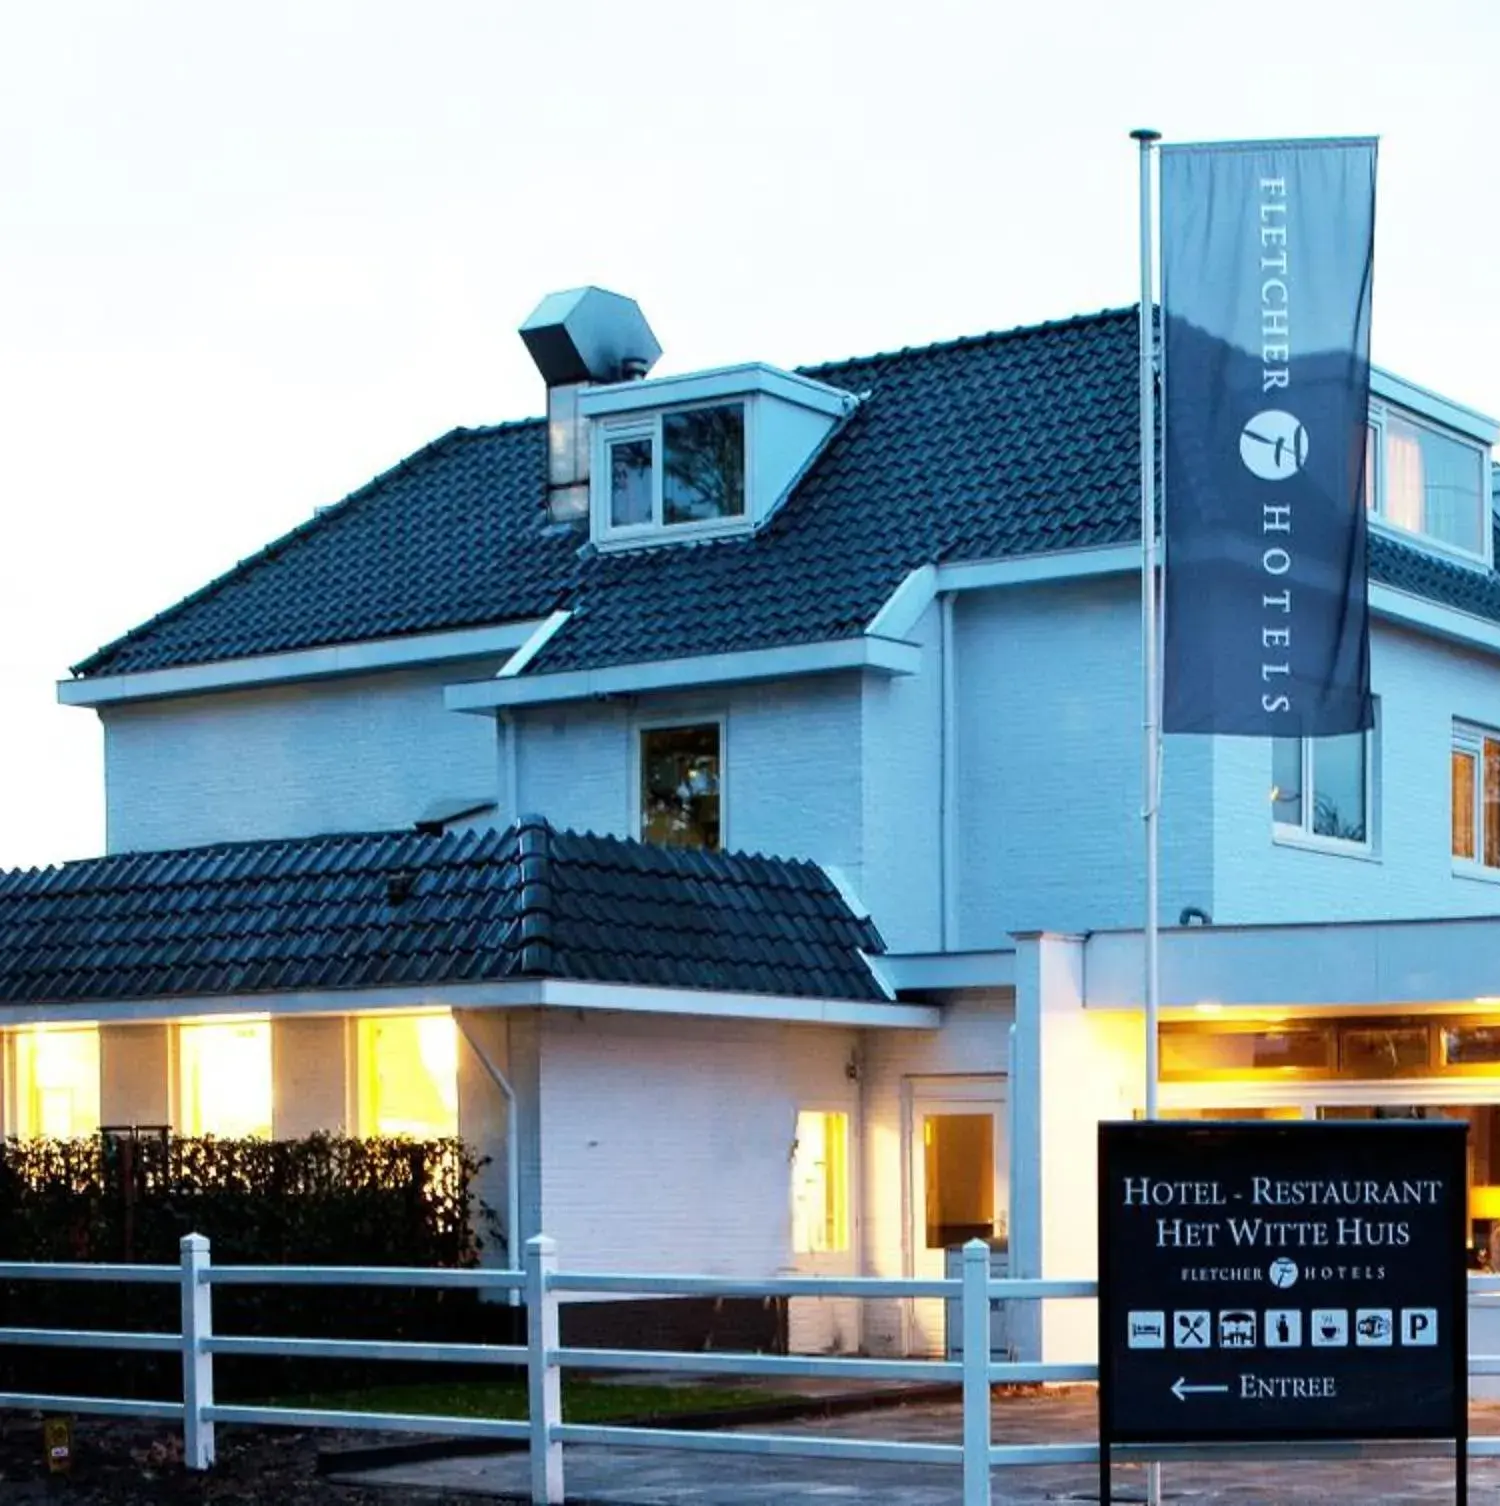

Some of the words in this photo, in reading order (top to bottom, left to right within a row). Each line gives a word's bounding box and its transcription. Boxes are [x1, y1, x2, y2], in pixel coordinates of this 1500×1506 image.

[1260, 176, 1290, 393] FLETCHER
[1262, 503, 1291, 712] HOTELS
[1123, 1176, 1227, 1206] HOTEL
[1251, 1176, 1443, 1205] RESTAURANT
[1155, 1217, 1220, 1248] HET
[1226, 1217, 1329, 1247] WITTE
[1336, 1217, 1411, 1247] HUIS
[1180, 1266, 1263, 1281] FLETCHER
[1304, 1264, 1386, 1281] HOTELS
[1239, 1373, 1337, 1399] ENTREE
